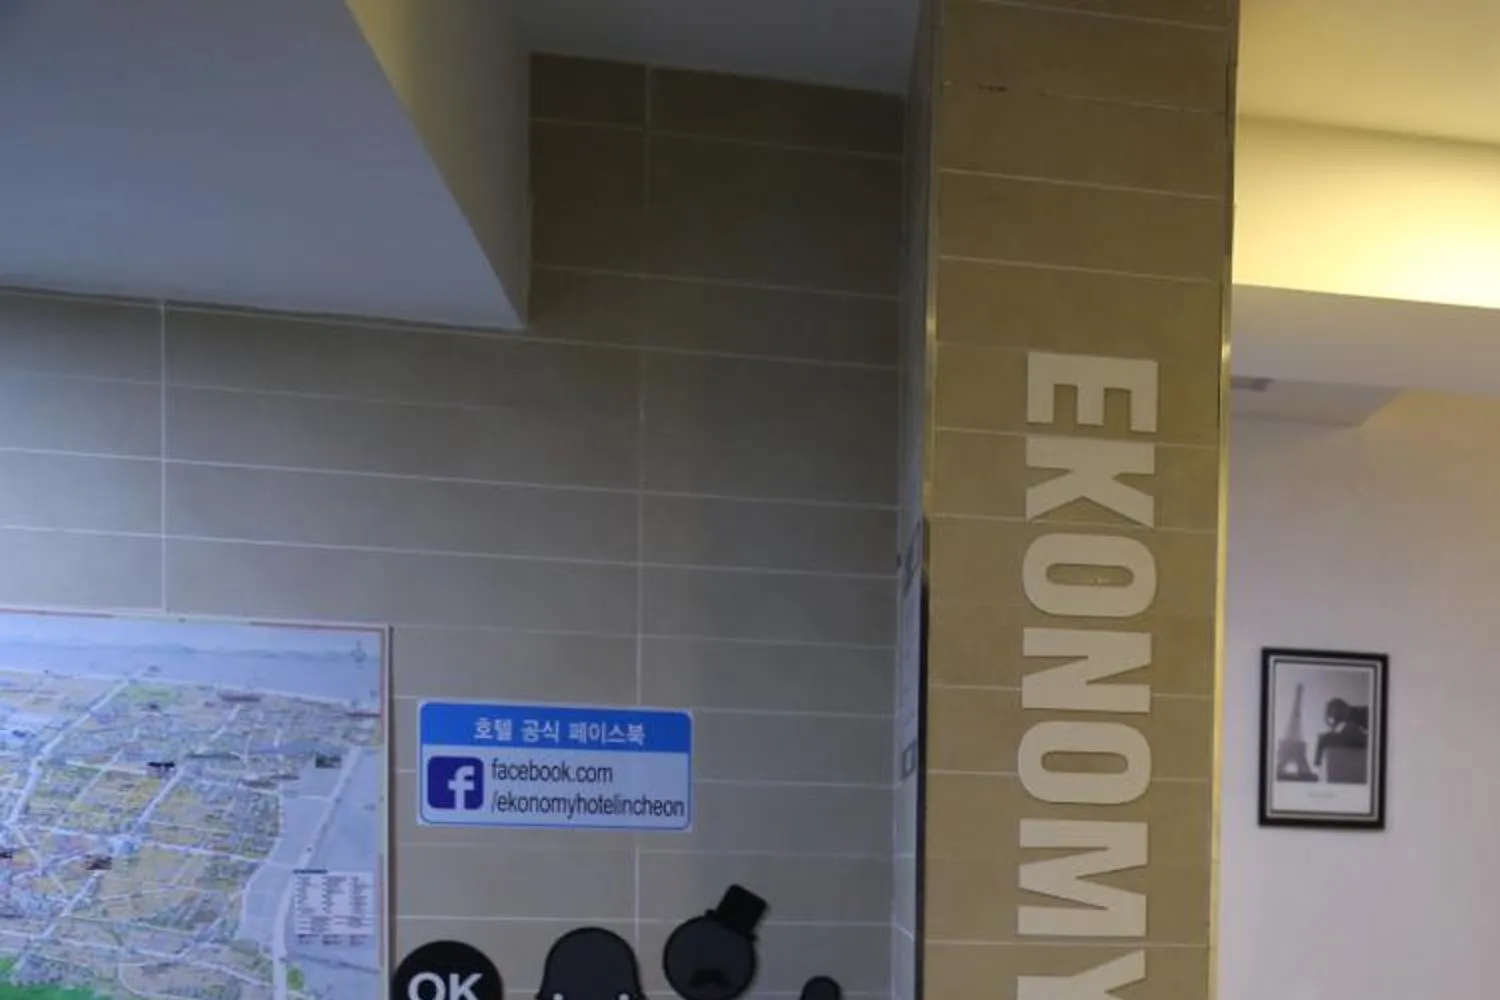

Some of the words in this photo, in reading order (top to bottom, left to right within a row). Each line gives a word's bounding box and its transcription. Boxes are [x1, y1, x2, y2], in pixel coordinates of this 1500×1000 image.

[474, 716, 512, 741] 호텔
[520, 719, 560, 743] 공식
[568, 722, 646, 746] 페이스북
[491, 758, 613, 784] facebook.com
[491, 793, 685, 820] /ekonomyhotelincheon
